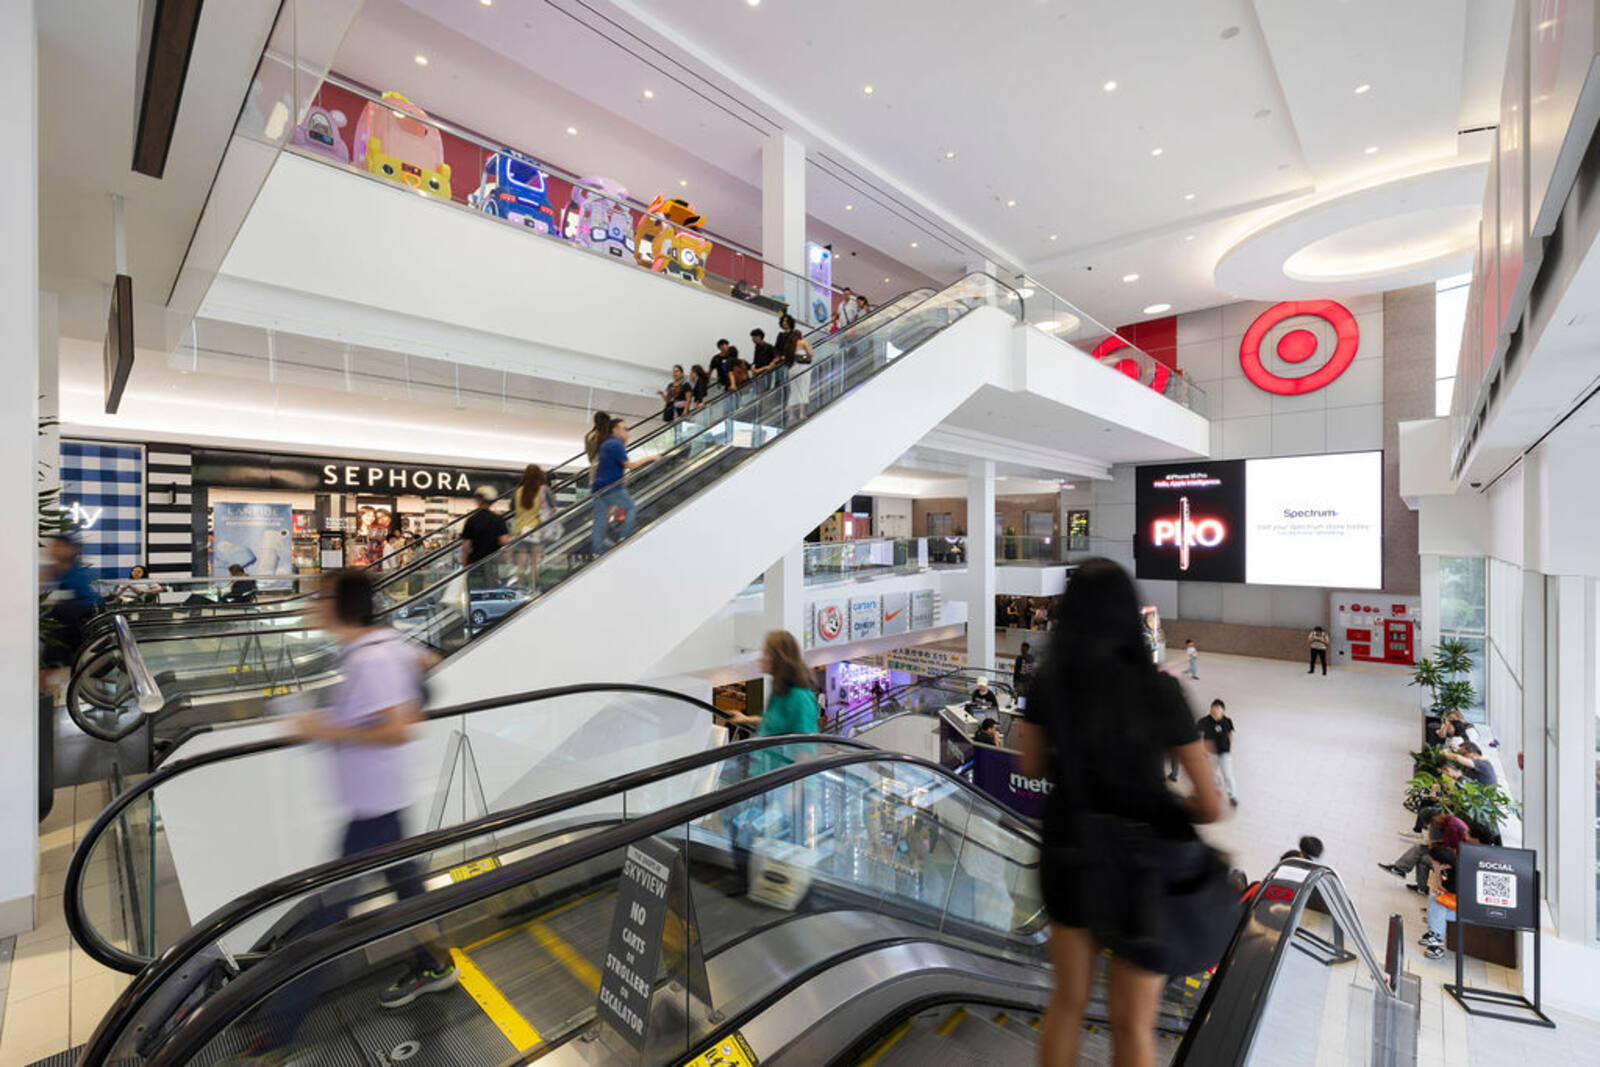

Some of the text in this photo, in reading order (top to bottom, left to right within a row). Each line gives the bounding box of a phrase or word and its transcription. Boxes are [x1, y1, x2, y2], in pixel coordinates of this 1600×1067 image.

[323, 464, 472, 492] SEPHORA
[1283, 508, 1336, 519] Spectrum
[623, 860, 667, 899] SKYVIEW
[1478, 860, 1515, 872] SOCIAL
[630, 901, 646, 926] NO
[622, 927, 646, 954] CARTS
[606, 953, 650, 999] STROLLERS
[600, 985, 644, 1036] ESCALATOR
